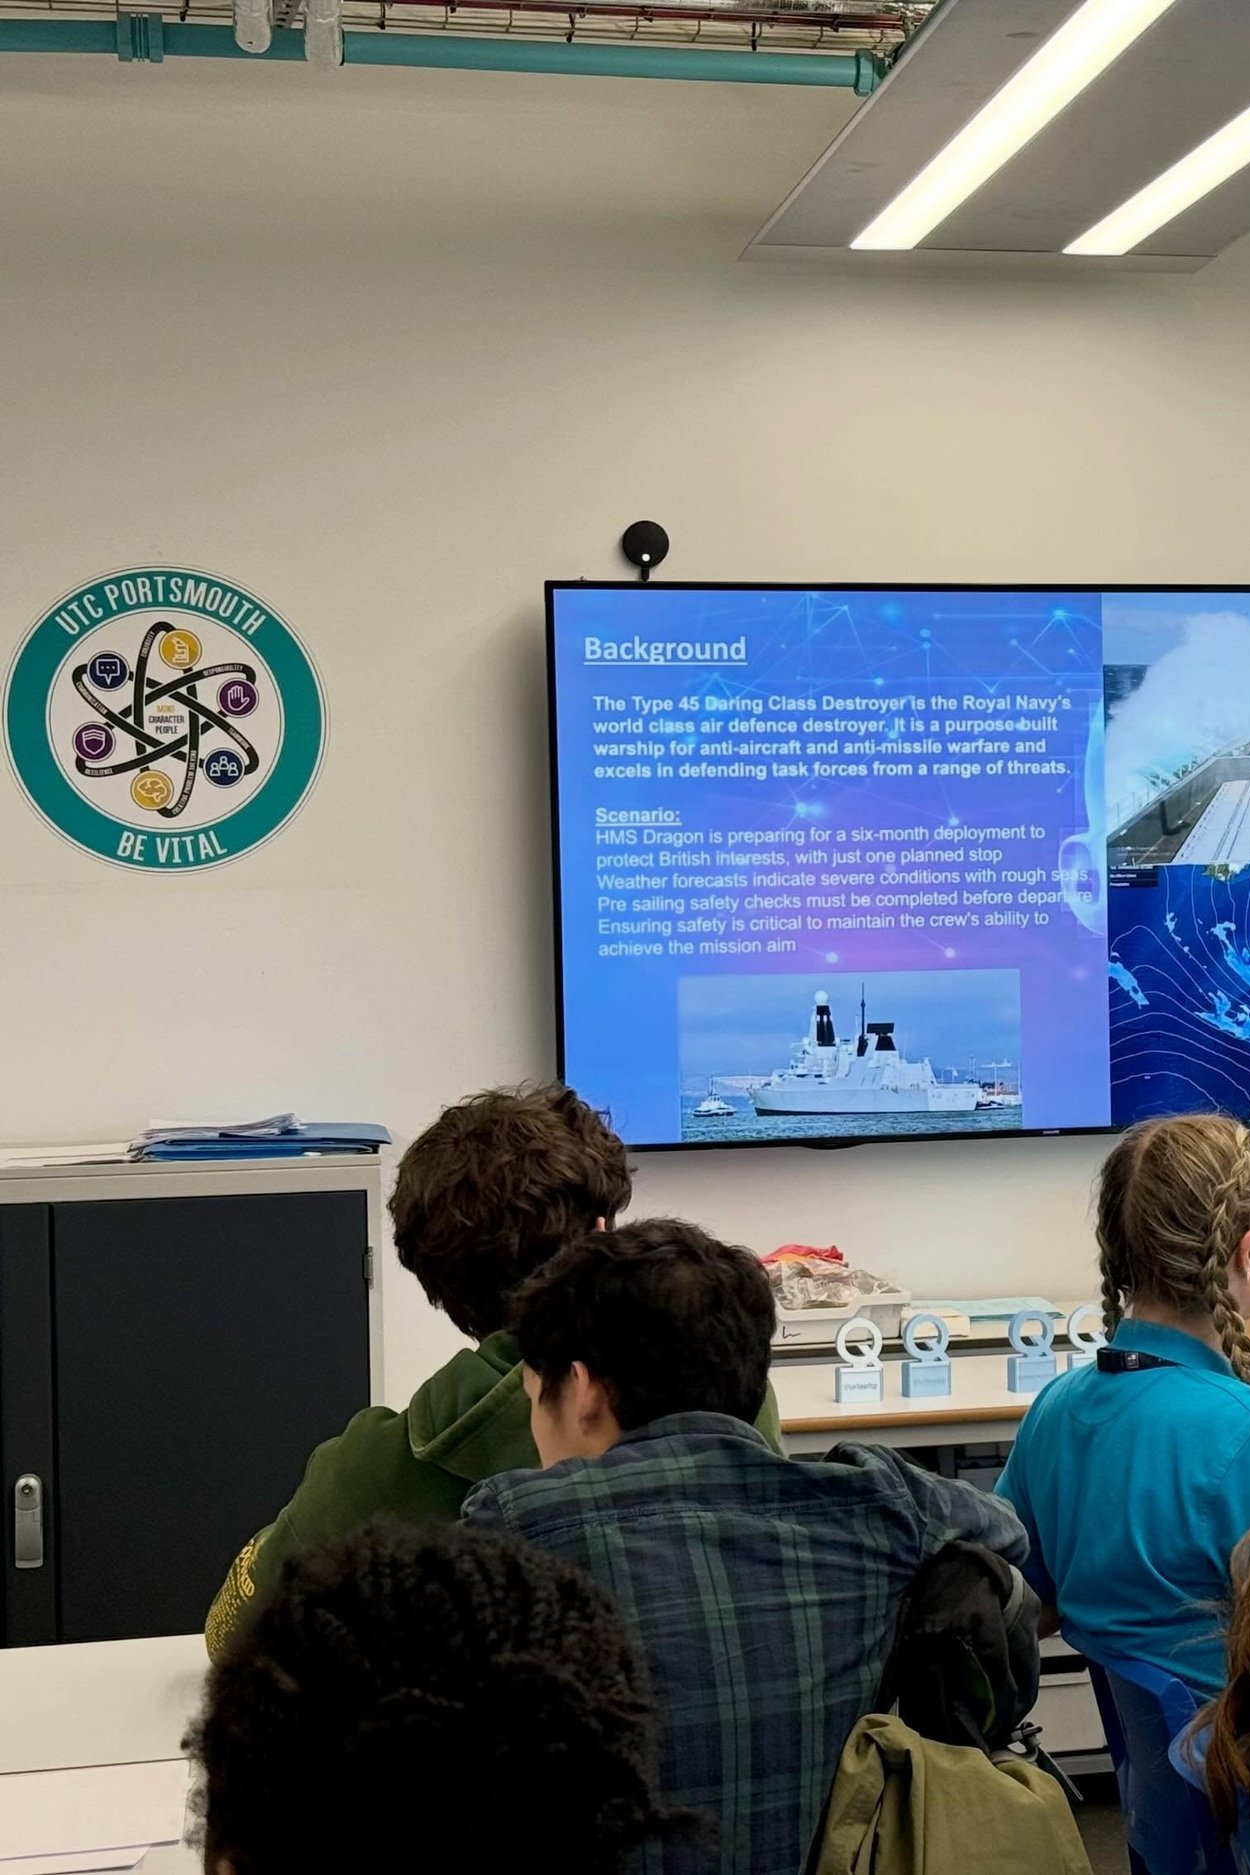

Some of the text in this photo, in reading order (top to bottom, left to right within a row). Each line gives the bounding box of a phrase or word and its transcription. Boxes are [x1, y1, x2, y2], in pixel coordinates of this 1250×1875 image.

[55, 576, 266, 636] UTC PORTSMOUTH
[584, 635, 747, 665] Background
[592, 695, 1071, 715] The Type 45 Daring Class Destroyer is the Royal Navy's
[148, 715, 185, 724] CHARACTER
[155, 725, 179, 734] PEOPLE
[593, 718, 643, 733] world
[648, 718, 695, 733] class
[701, 718, 723, 733] air
[728, 718, 797, 733] defence
[803, 717, 889, 736] destroyer.
[894, 717, 905, 732] It
[910, 717, 925, 732] is
[930, 720, 940, 732] a
[593, 738, 1046, 758] warship for anti-aircraft and anti-missile warfare and
[594, 760, 1071, 780] excels in defending task forces from a range of threats.
[595, 807, 682, 824] Scenario:
[596, 825, 1045, 847] HMS Dragon is preparing for a six-month deployment to
[117, 830, 228, 863] BE VITAL
[597, 848, 1002, 870] protect British interests, with just one planned stop
[597, 873, 668, 889] Weather
[673, 873, 748, 889] forecasts
[753, 872, 816, 887] indicate
[820, 872, 875, 885] severe
[880, 869, 960, 884] conditions
[965, 868, 996, 883] with
[1002, 868, 1046, 885] rough
[598, 889, 1092, 914] Pre sailing safety checks must be completed before deparre
[598, 911, 1049, 936] Ensuring safety is critical to maintain the crew's ability to
[599, 937, 796, 956] achieve the mission aim
